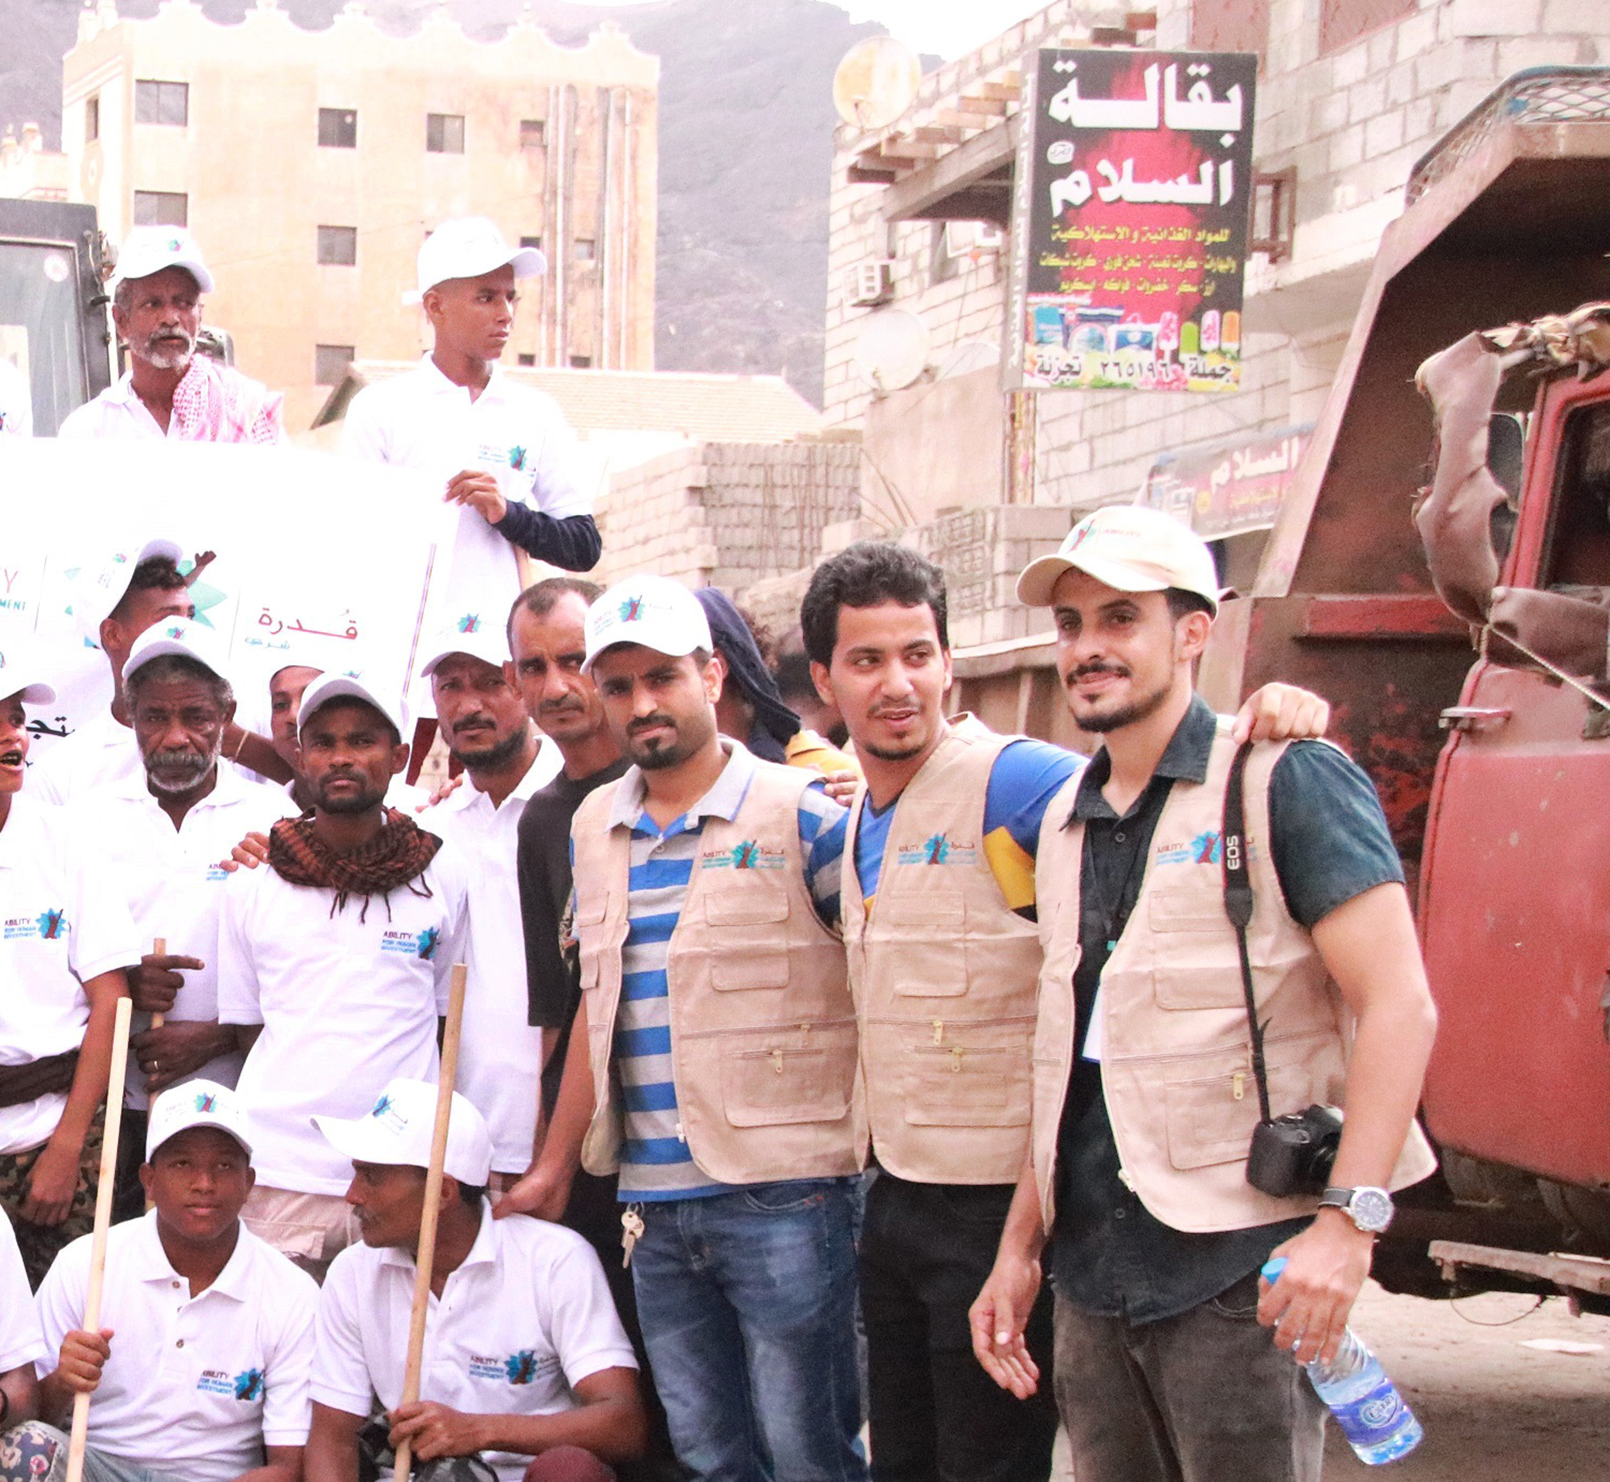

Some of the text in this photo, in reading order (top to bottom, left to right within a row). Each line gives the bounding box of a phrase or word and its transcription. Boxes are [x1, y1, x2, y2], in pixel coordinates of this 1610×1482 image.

[1048, 60, 1243, 149] بقالة
[1050, 157, 1233, 218] السلام
[1195, 228, 1231, 245] للمواد
[1188, 355, 1233, 384] جملة
[1210, 436, 1300, 494] السلام
[1226, 835, 1240, 870] EOS
